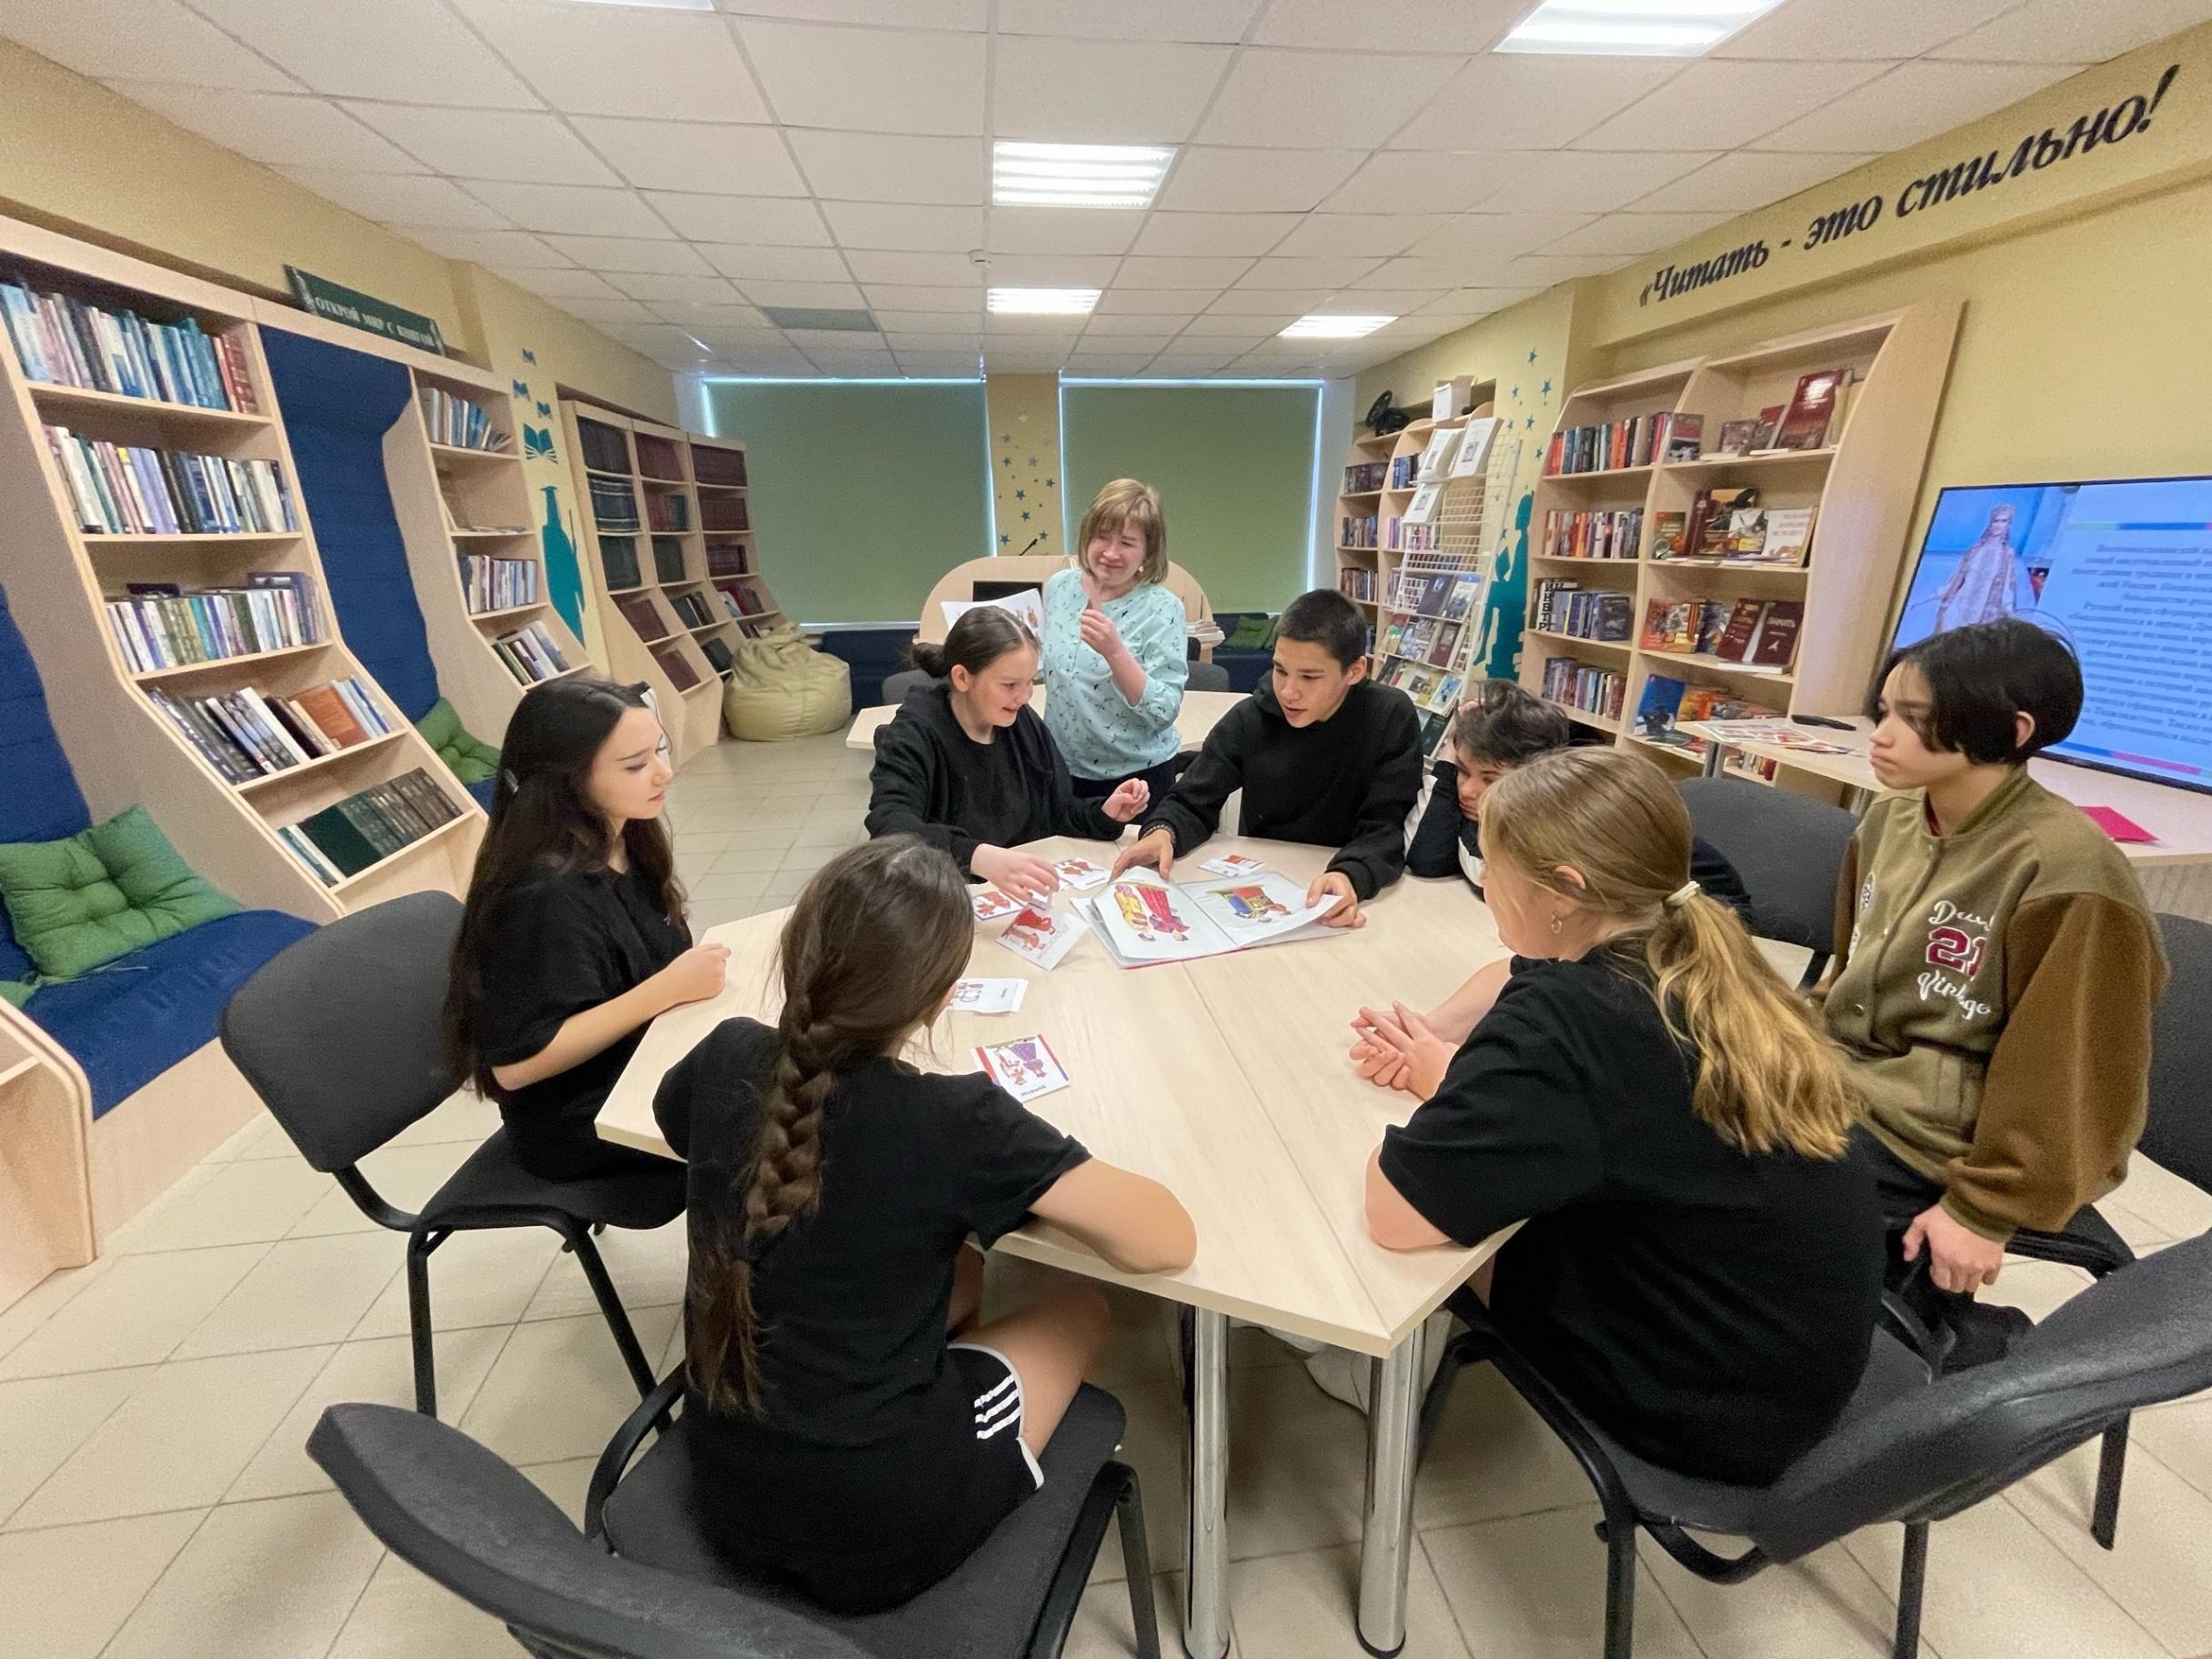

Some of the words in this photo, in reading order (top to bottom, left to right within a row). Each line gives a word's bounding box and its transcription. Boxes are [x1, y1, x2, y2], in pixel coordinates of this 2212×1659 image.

[1639, 240, 1770, 307] «Читать
[1804, 195, 1884, 251] это
[1895, 64, 2181, 218] стильно!
[1925, 925, 1988, 981] 21
